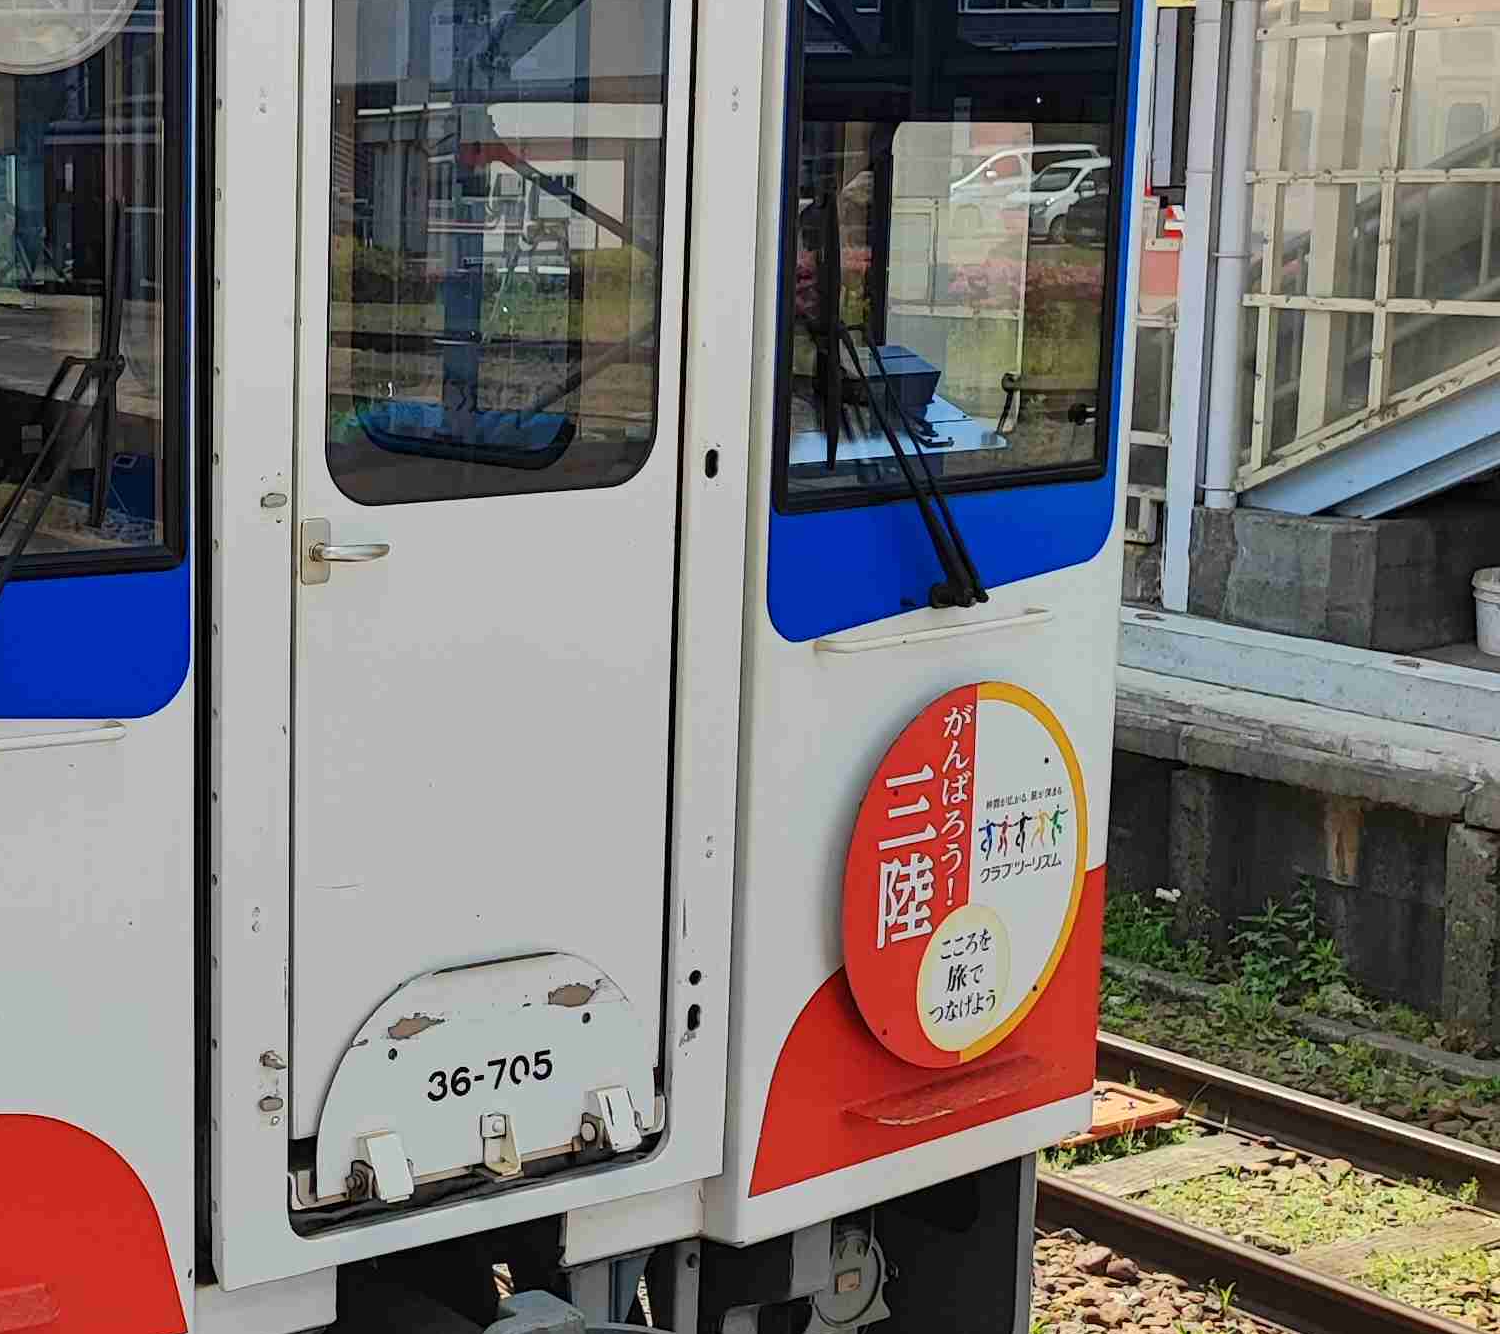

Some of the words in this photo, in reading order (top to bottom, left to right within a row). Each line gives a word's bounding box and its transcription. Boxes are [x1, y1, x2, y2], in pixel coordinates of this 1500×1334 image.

[940, 703, 975, 907] がんばろう!
[877, 763, 939, 950] 三陸
[940, 928, 992, 960] こころを
[945, 963, 984, 993] 旅で
[928, 989, 996, 1024] つなげよう
[427, 1049, 553, 1102] 36-705
